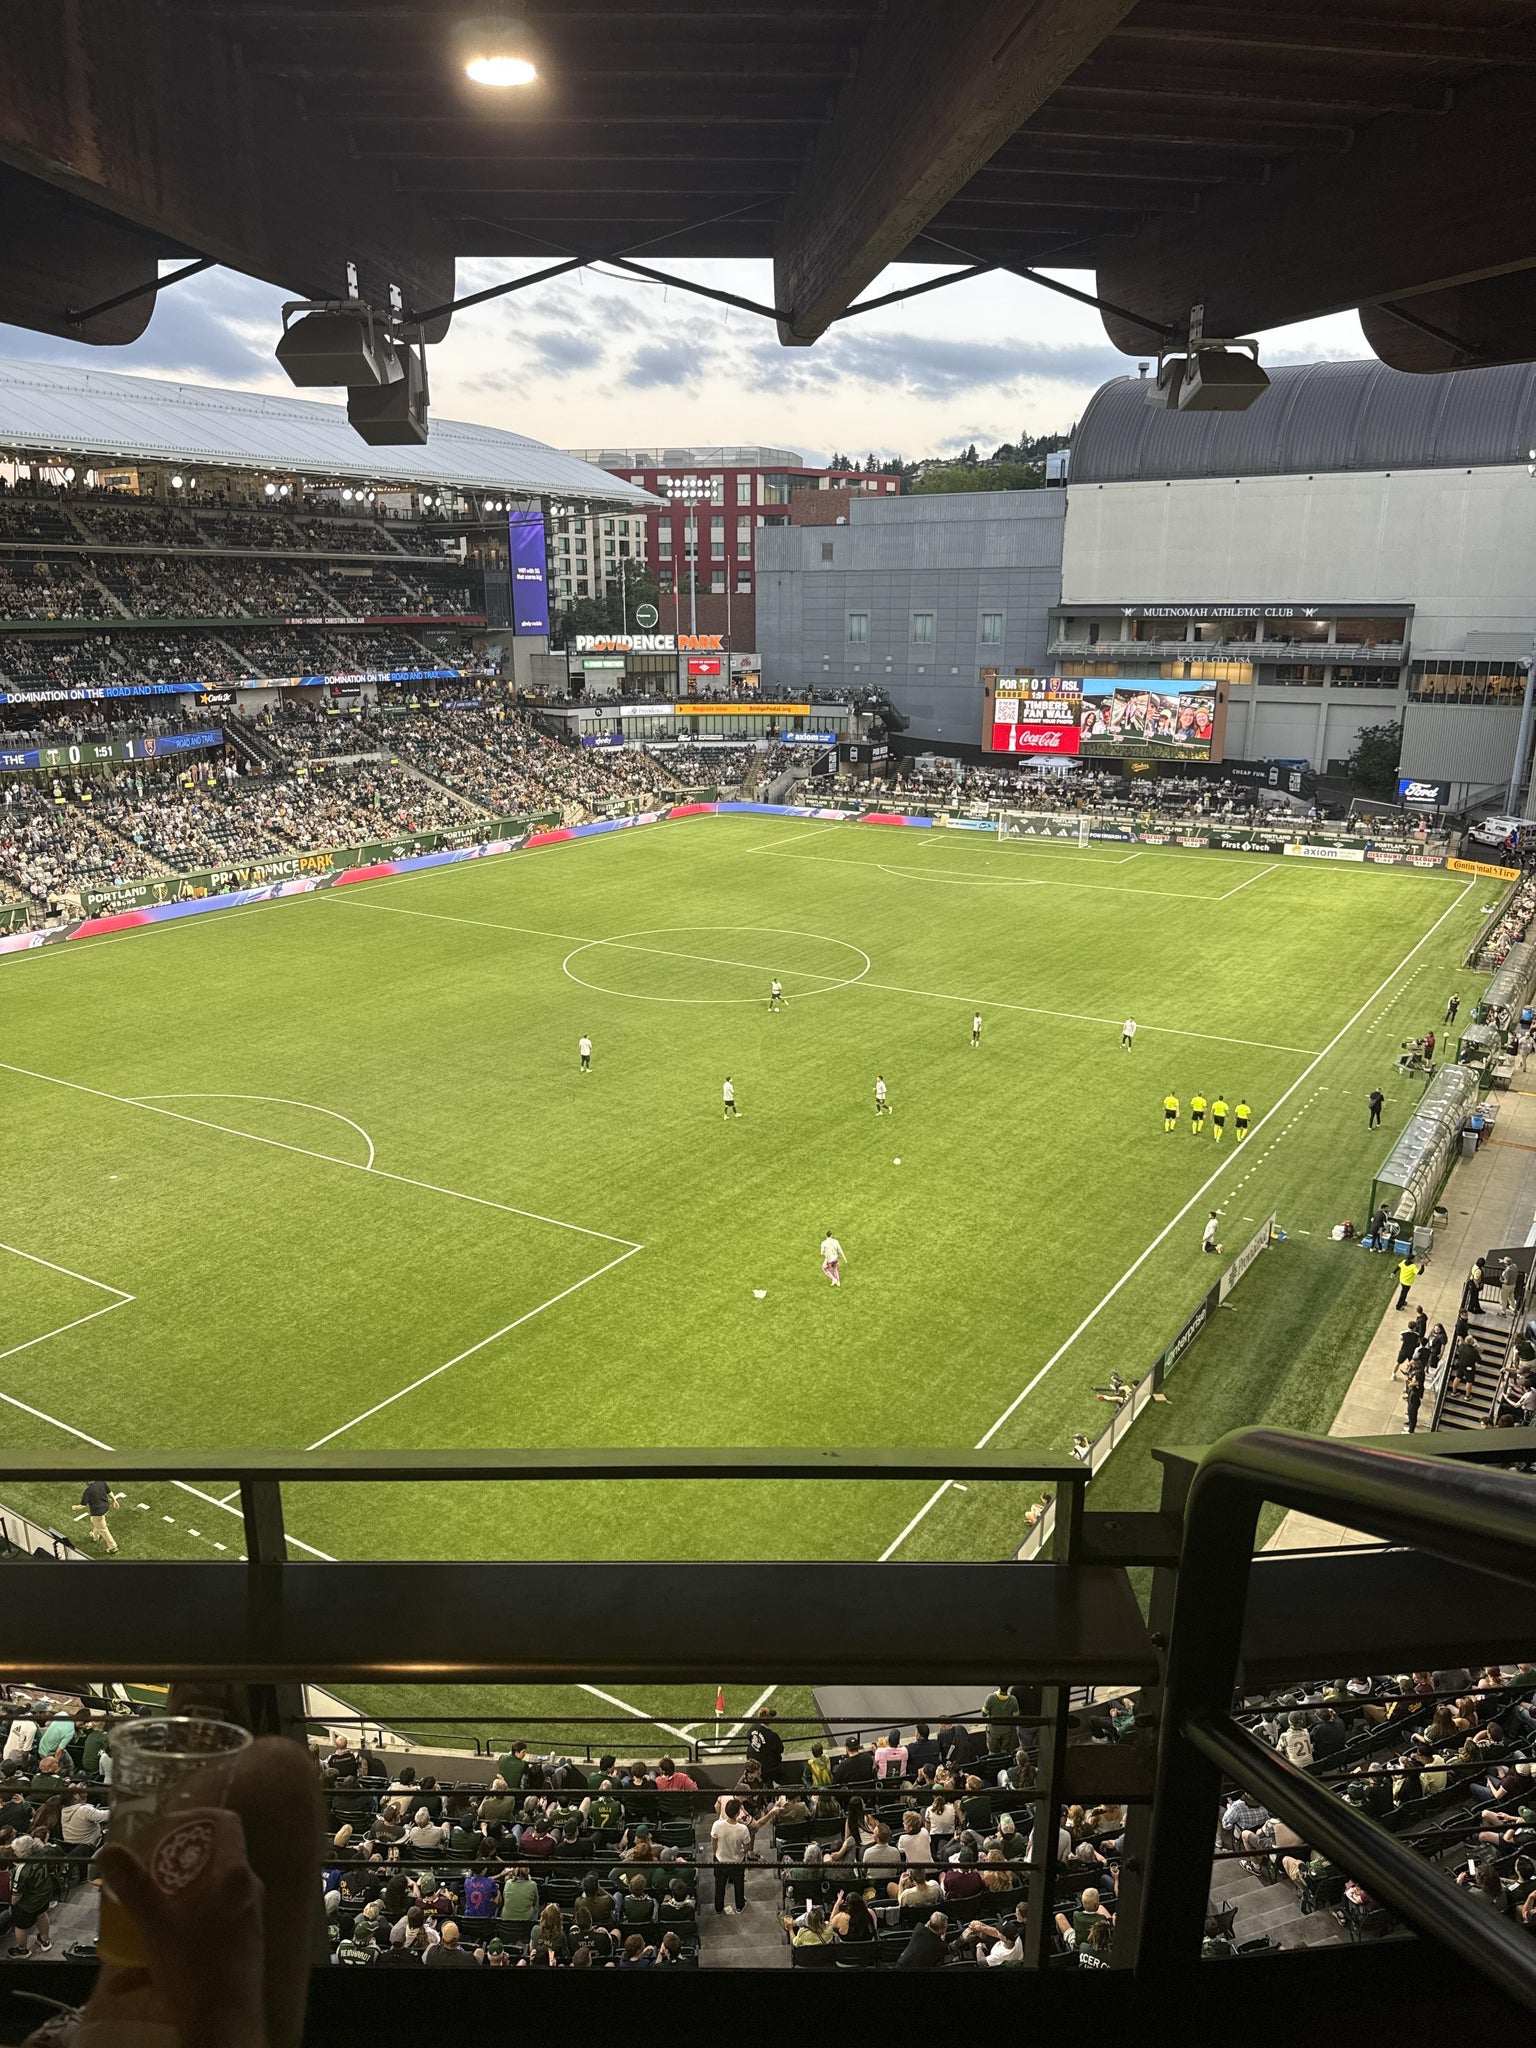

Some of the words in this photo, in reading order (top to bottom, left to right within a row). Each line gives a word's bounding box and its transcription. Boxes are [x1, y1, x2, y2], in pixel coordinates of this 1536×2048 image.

[1143, 608, 1208, 617] MULTNOMAH
[1211, 608, 1261, 617] ATHLETIC
[1265, 608, 1294, 617] CLUB
[576, 634, 675, 651] PROVIDENCE
[678, 634, 724, 651] PARK
[1177, 655, 1208, 663] SOCCER
[1212, 655, 1230, 663] CITY
[325, 674, 366, 684] DOMINATION
[367, 673, 377, 683] ON
[378, 673, 390, 682] THE
[391, 672, 409, 682] ROAD
[410, 672, 423, 680] AND
[1000, 679, 1017, 689] POR
[1031, 679, 1038, 690] 0
[1041, 679, 1047, 690] 1
[1061, 681, 1079, 691] RSL
[7, 690, 69, 703] DOMINATION
[70, 690, 86, 700] ON
[88, 688, 104, 698] THE
[107, 687, 131, 697] ROAD
[133, 686, 151, 695] AND
[153, 685, 176, 694] TRAIL
[1032, 691, 1045, 699] 1:51
[1024, 700, 1069, 710] TIMBERS
[1024, 709, 1043, 718] FAN
[1046, 710, 1073, 719] WALL
[795, 733, 818, 742] axiom
[1019, 730, 1064, 748] Coca-Cola
[2, 754, 25, 765] THE
[69, 746, 81, 764] 0
[94, 745, 113, 758] 1:51
[126, 740, 134, 758] 1
[1405, 782, 1438, 798] Ford
[1140, 833, 1170, 841] DISCOUNT
[1176, 836, 1208, 844] DISCOUNT
[1222, 841, 1240, 849] First
[1251, 843, 1270, 851] Tech
[1304, 848, 1337, 857] axiom
[1367, 851, 1402, 859] DISCOUNT
[300, 853, 334, 870] PARK
[1406, 855, 1442, 863] DISCOUNT
[1498, 868, 1515, 878] Tire
[88, 886, 147, 905] PORTLAND
[1167, 1308, 1207, 1366] enterprise
[1294, 1740, 1310, 1757] 21
[600, 1814, 610, 1829] 7
[471, 1891, 483, 1911] 9
